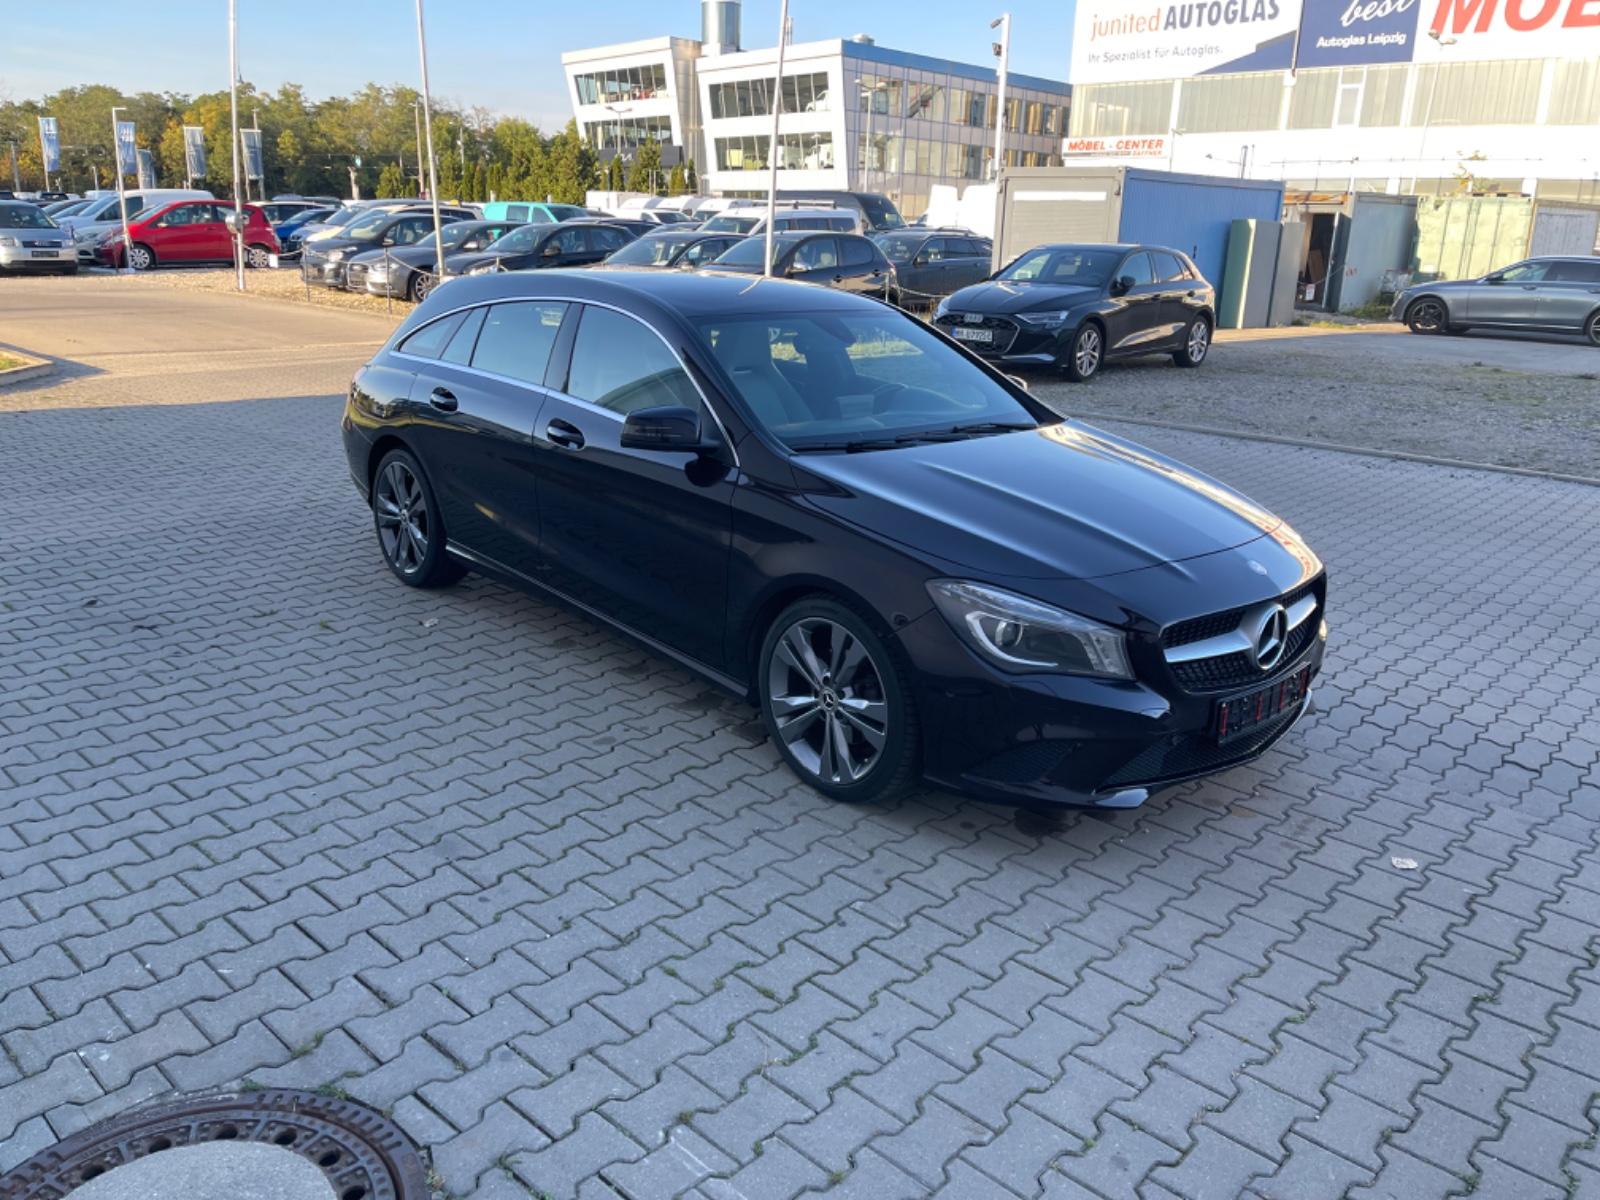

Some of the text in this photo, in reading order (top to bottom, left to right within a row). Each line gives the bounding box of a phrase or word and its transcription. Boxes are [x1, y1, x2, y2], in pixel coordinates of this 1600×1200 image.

[1090, 0, 1280, 41] junited AUTOGLAS
[1316, 32, 1407, 48] Autoglas Leipzig
[1088, 53, 1100, 63] Ihr
[1103, 49, 1151, 63] Spezialist
[1172, 44, 1223, 58] Autoglas.
[1068, 139, 1105, 151] MÖBEL
[1116, 139, 1164, 150] CENTER
